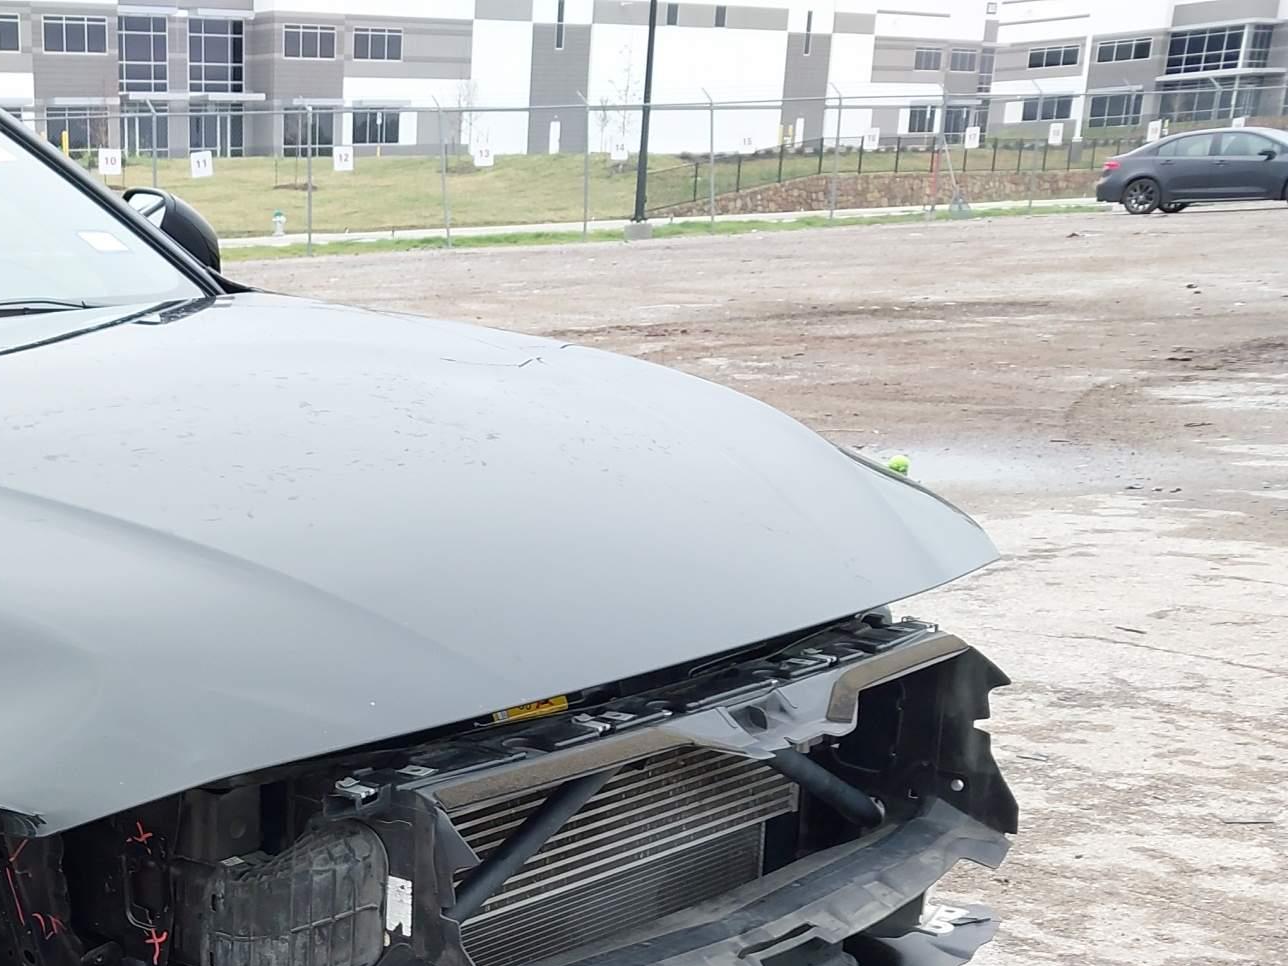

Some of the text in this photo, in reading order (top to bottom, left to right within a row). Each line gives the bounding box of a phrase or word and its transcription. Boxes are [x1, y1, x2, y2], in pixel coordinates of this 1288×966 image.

[338, 153, 349, 162] 12
[479, 149, 490, 158] 13
[104, 156, 117, 166] 10
[196, 159, 207, 169] 11
